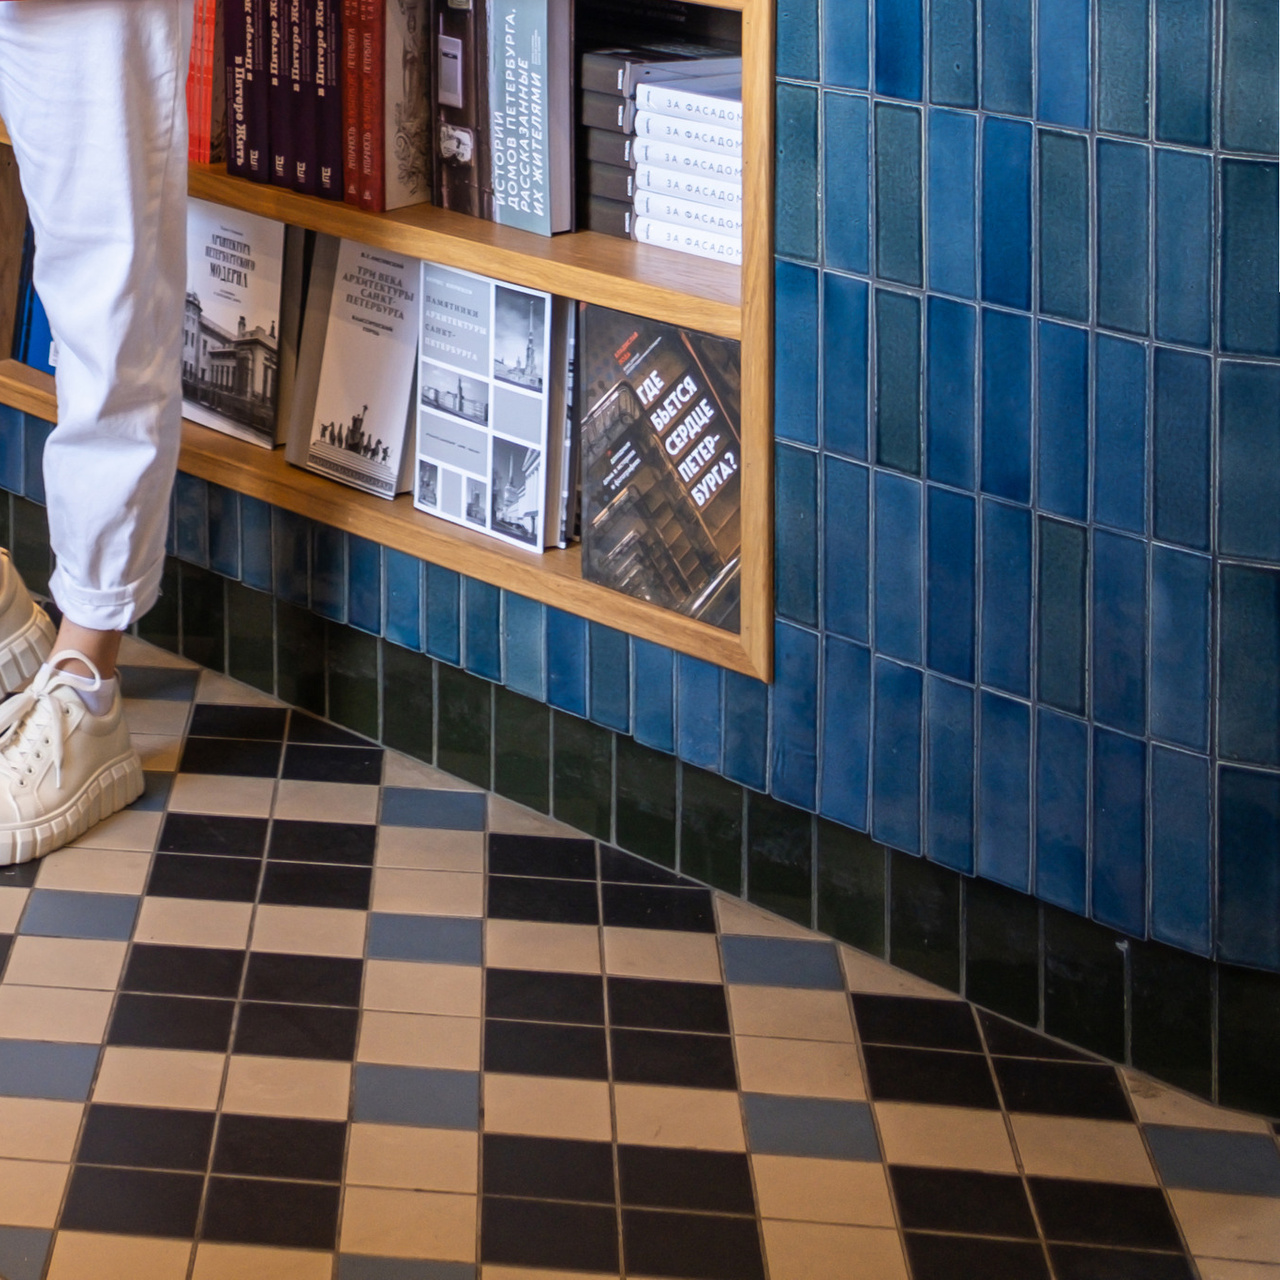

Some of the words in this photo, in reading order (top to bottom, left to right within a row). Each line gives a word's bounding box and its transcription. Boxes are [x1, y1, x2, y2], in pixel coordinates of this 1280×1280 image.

[505, 8, 517, 129] ПЕТЕРБУРГА.
[666, 99, 680, 109] ЗА
[518, 57, 531, 213] РАССКАЗАННЫЕ
[531, 72, 544, 185] ЖИТЕЛЯМИ
[666, 126, 680, 137] ЗА
[494, 111, 506, 206] ИСТОРИИ
[664, 153, 678, 164] ЗА
[506, 139, 520, 211] ДОМОВ
[666, 179, 680, 190] ЗА
[533, 192, 544, 217] ИХ
[665, 205, 679, 216] ЗА
[665, 232, 679, 243] ЗА
[342, 273, 414, 302] АРХИТЕКТУРЫ
[357, 266, 377, 279] ТРИ
[378, 272, 403, 288] ВЕКА
[345, 294, 404, 320] ПЕТЕРБУРГА
[360, 288, 397, 305] САНКТ-
[425, 295, 479, 318] ПАМЯТНИКИ
[425, 310, 487, 335] АРХИТЕКТУРЫ
[424, 336, 478, 362] ПЕТЕРБУРГА
[636, 369, 665, 405] ГДЕ
[649, 375, 698, 432] БЬЕТСЯ
[665, 397, 715, 456] СЕРДЦЕ
[677, 434, 721, 483] ПЕТЕР-
[690, 452, 738, 507] БУРГА?
